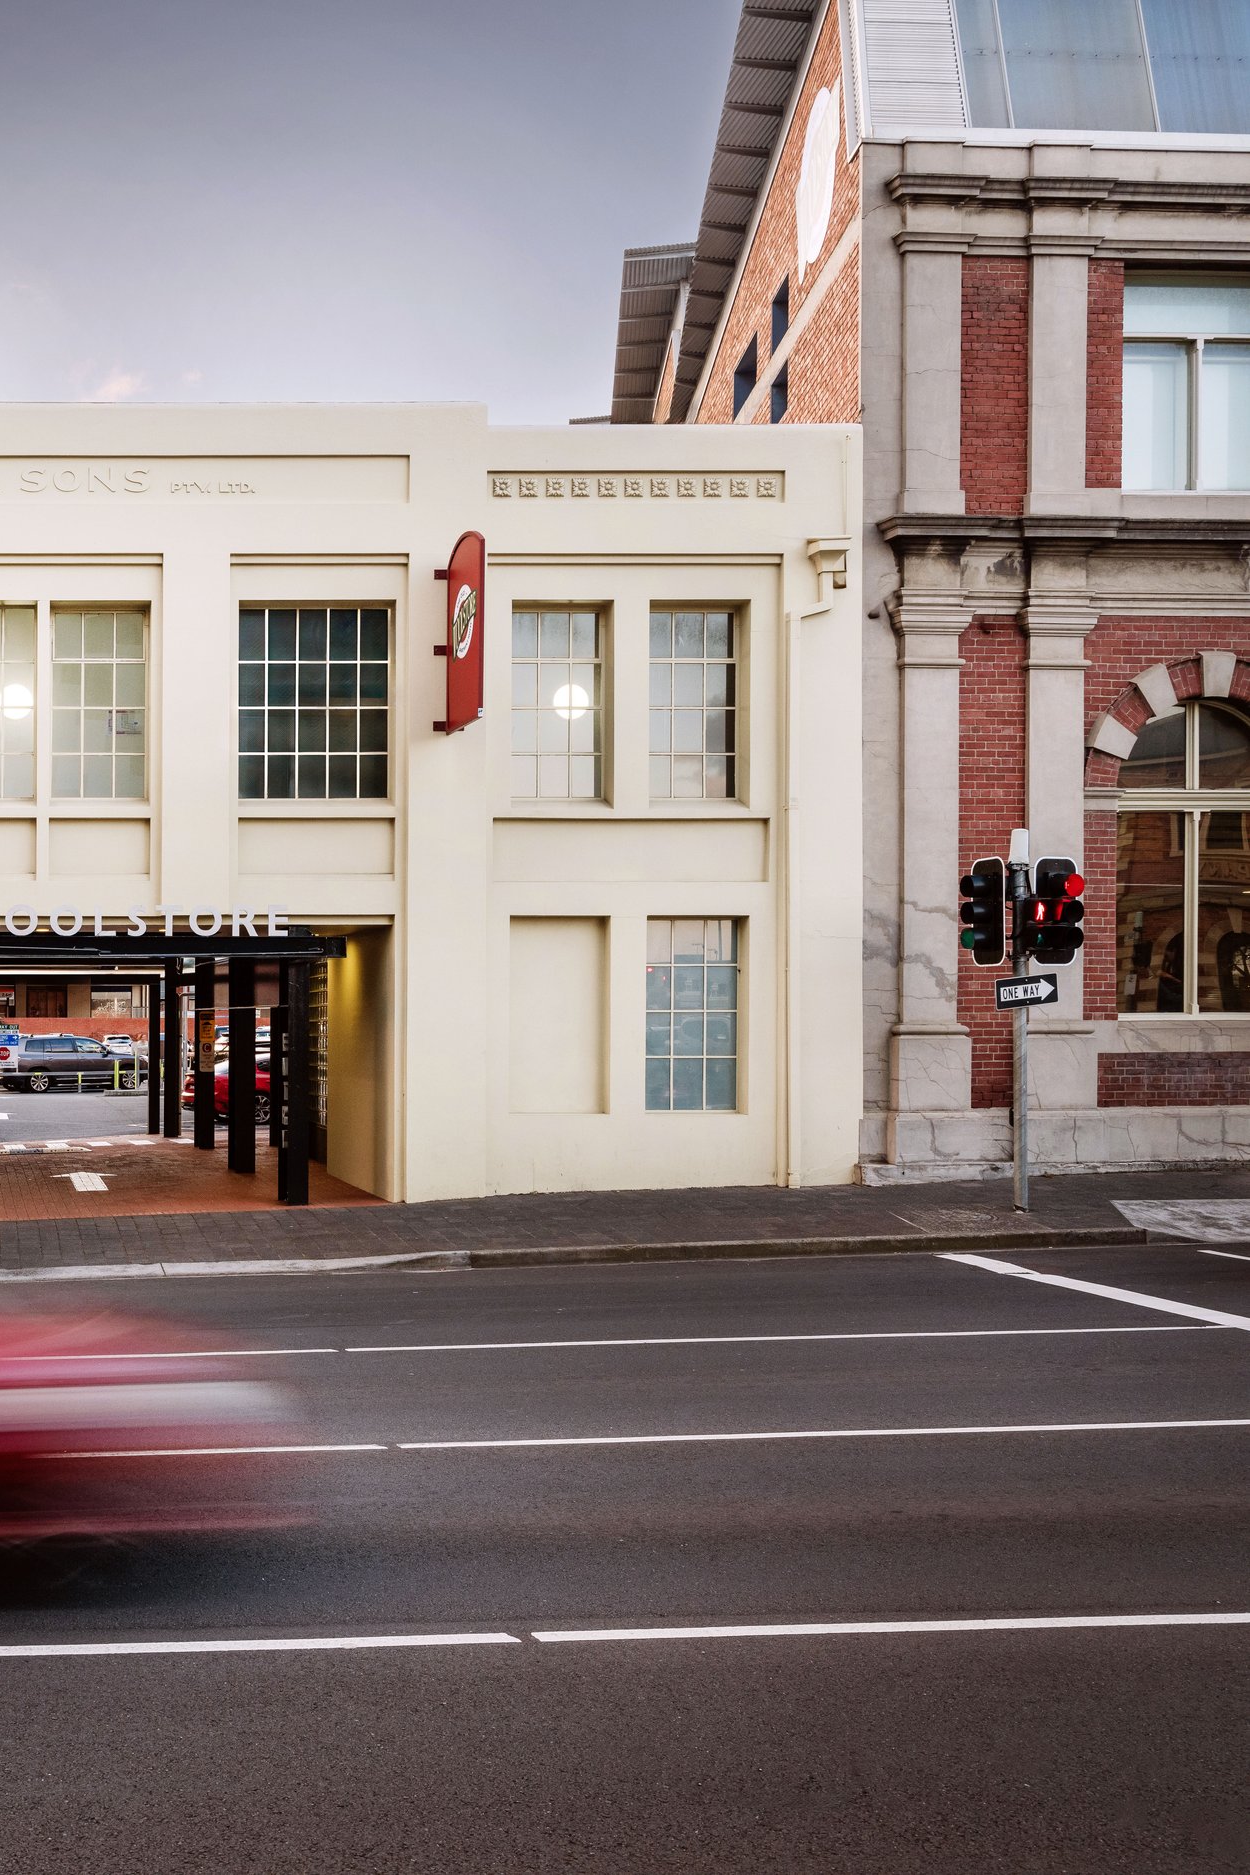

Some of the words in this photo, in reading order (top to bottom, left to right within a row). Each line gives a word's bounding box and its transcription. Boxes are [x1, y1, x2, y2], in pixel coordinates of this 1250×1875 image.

[20, 467, 150, 493] SONS
[218, 482, 255, 493] LTD.
[1003, 987, 1019, 999] ONE
[1023, 985, 1040, 997] WAY
